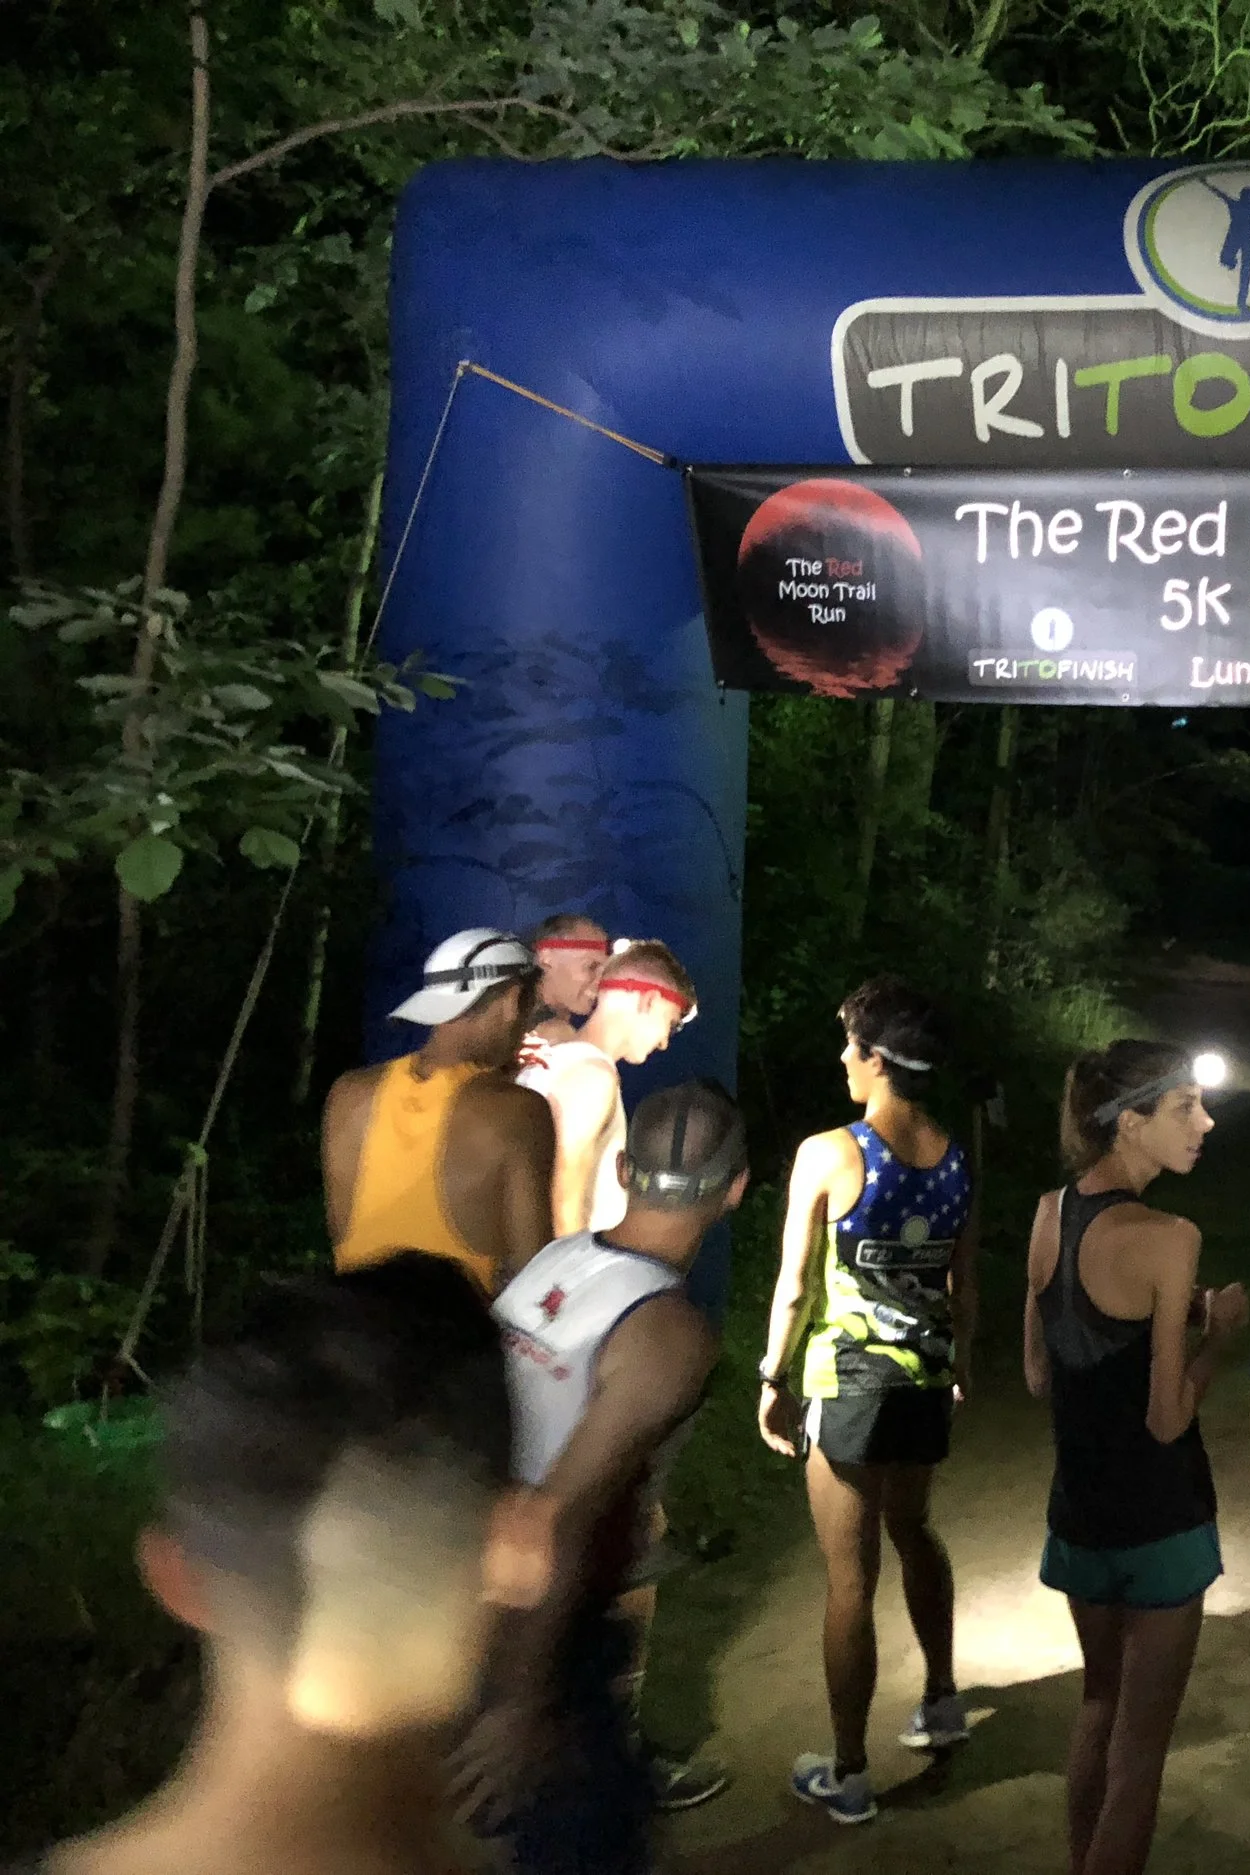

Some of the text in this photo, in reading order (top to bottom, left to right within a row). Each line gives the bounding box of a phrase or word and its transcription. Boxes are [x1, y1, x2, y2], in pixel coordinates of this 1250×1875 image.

[955, 499, 1083, 564] The
[1095, 499, 1228, 565] Red
[784, 557, 864, 579] The Red
[778, 580, 877, 602] Moon Trail
[808, 603, 846, 625] Run
[1160, 575, 1233, 632] 5K
[973, 657, 1135, 682] TRITOFINISH
